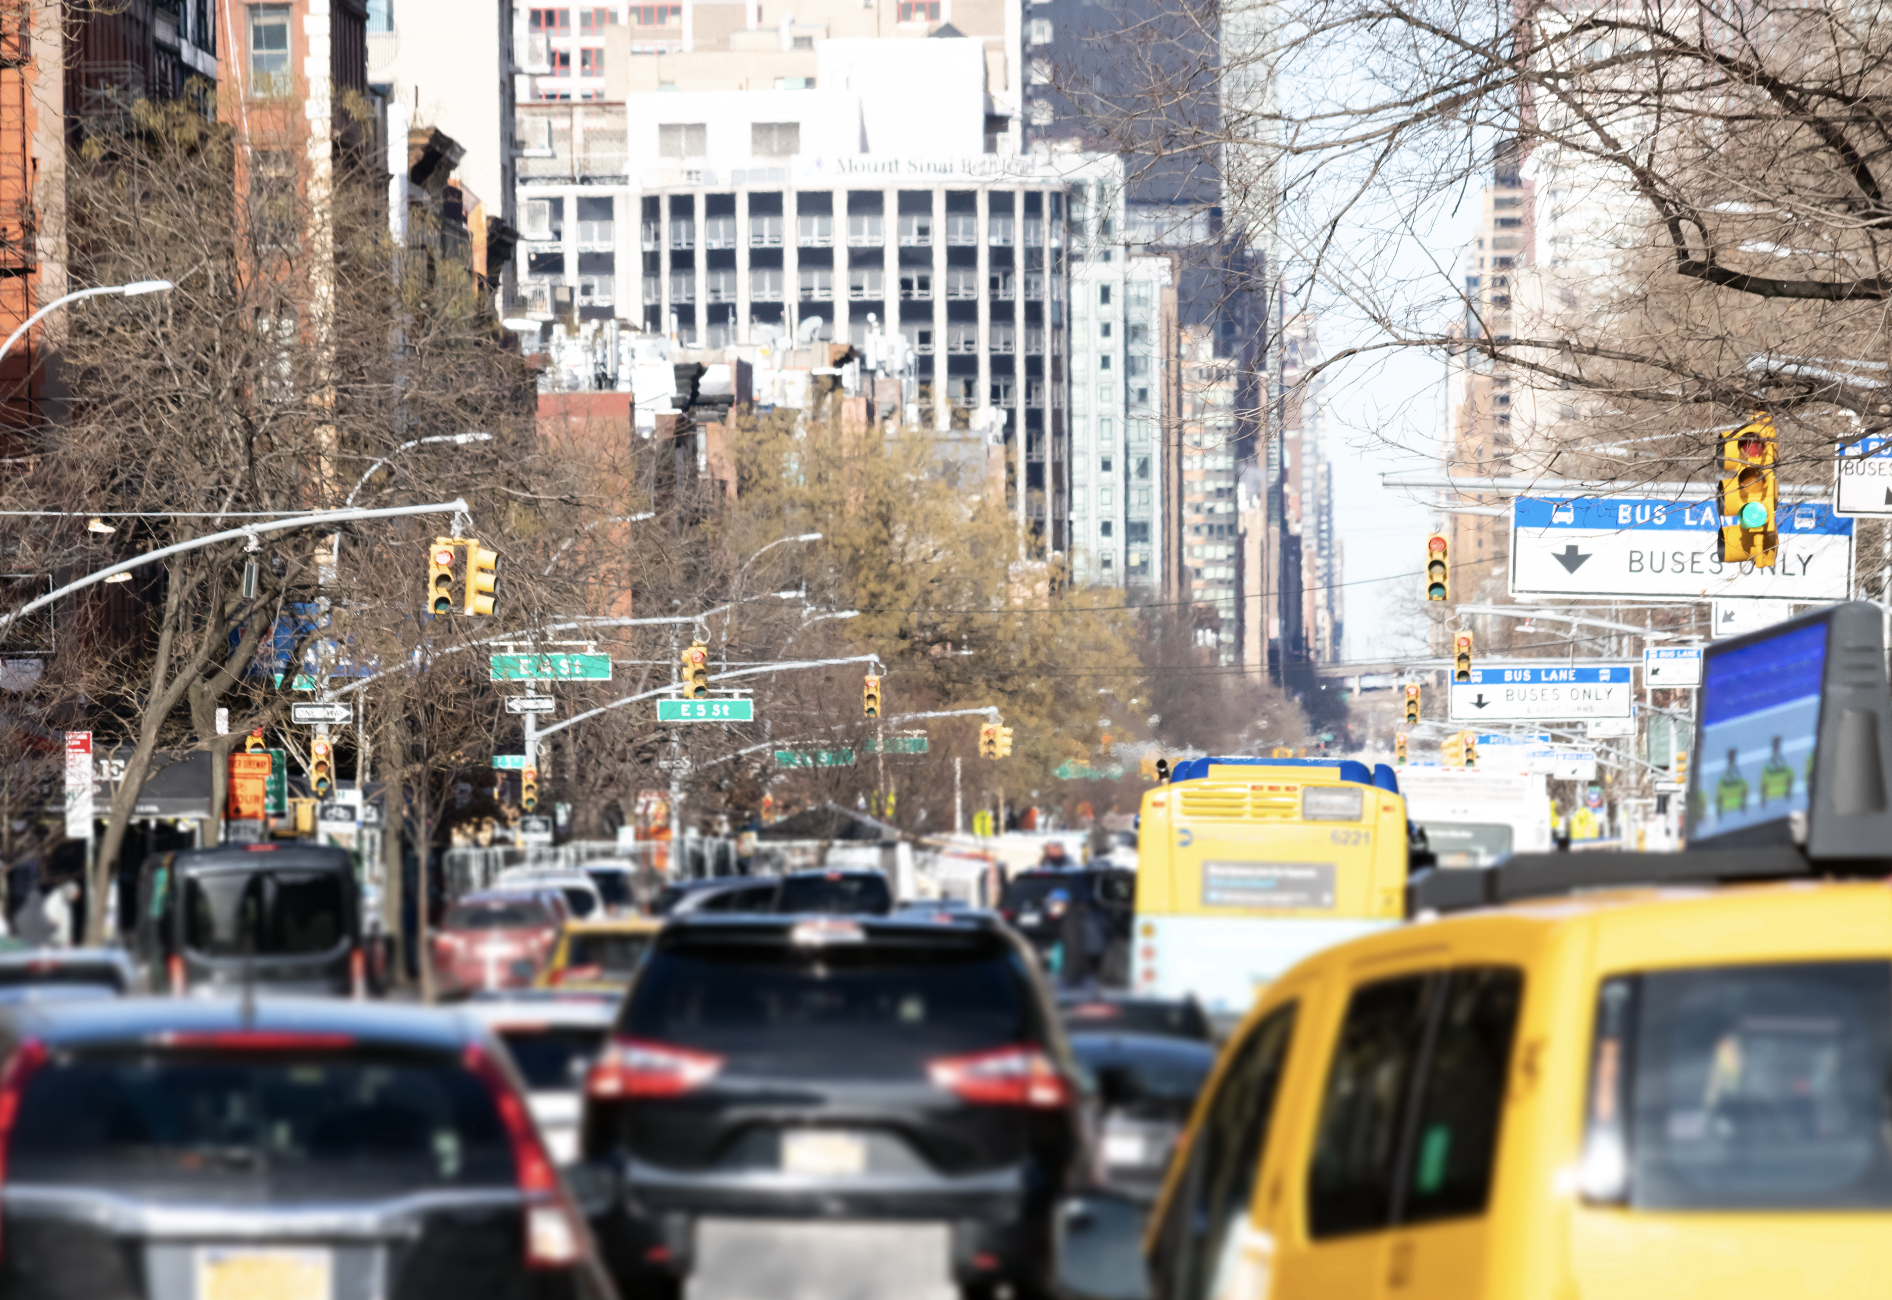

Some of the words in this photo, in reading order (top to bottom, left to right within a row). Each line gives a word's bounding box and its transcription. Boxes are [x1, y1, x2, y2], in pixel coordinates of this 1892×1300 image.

[836, 157, 899, 175] Mount
[907, 156, 954, 175] Sinai
[1617, 504, 1666, 525] BUS
[1684, 505, 1734, 526] LAN
[1628, 550, 1724, 575] BUSES
[520, 658, 532, 675] E
[540, 659, 552, 675] 4
[559, 658, 582, 675] St
[1504, 669, 1531, 681] BUS
[1541, 669, 1577, 681] LANE
[1505, 688, 1560, 702] BUSES
[1570, 687, 1613, 701] ONLY
[297, 708, 316, 718] ONE
[681, 704, 692, 717] E
[696, 704, 707, 717] 5
[712, 704, 730, 717] St
[1566, 705, 1595, 713] TURNS
[1329, 829, 1371, 847] 6221
